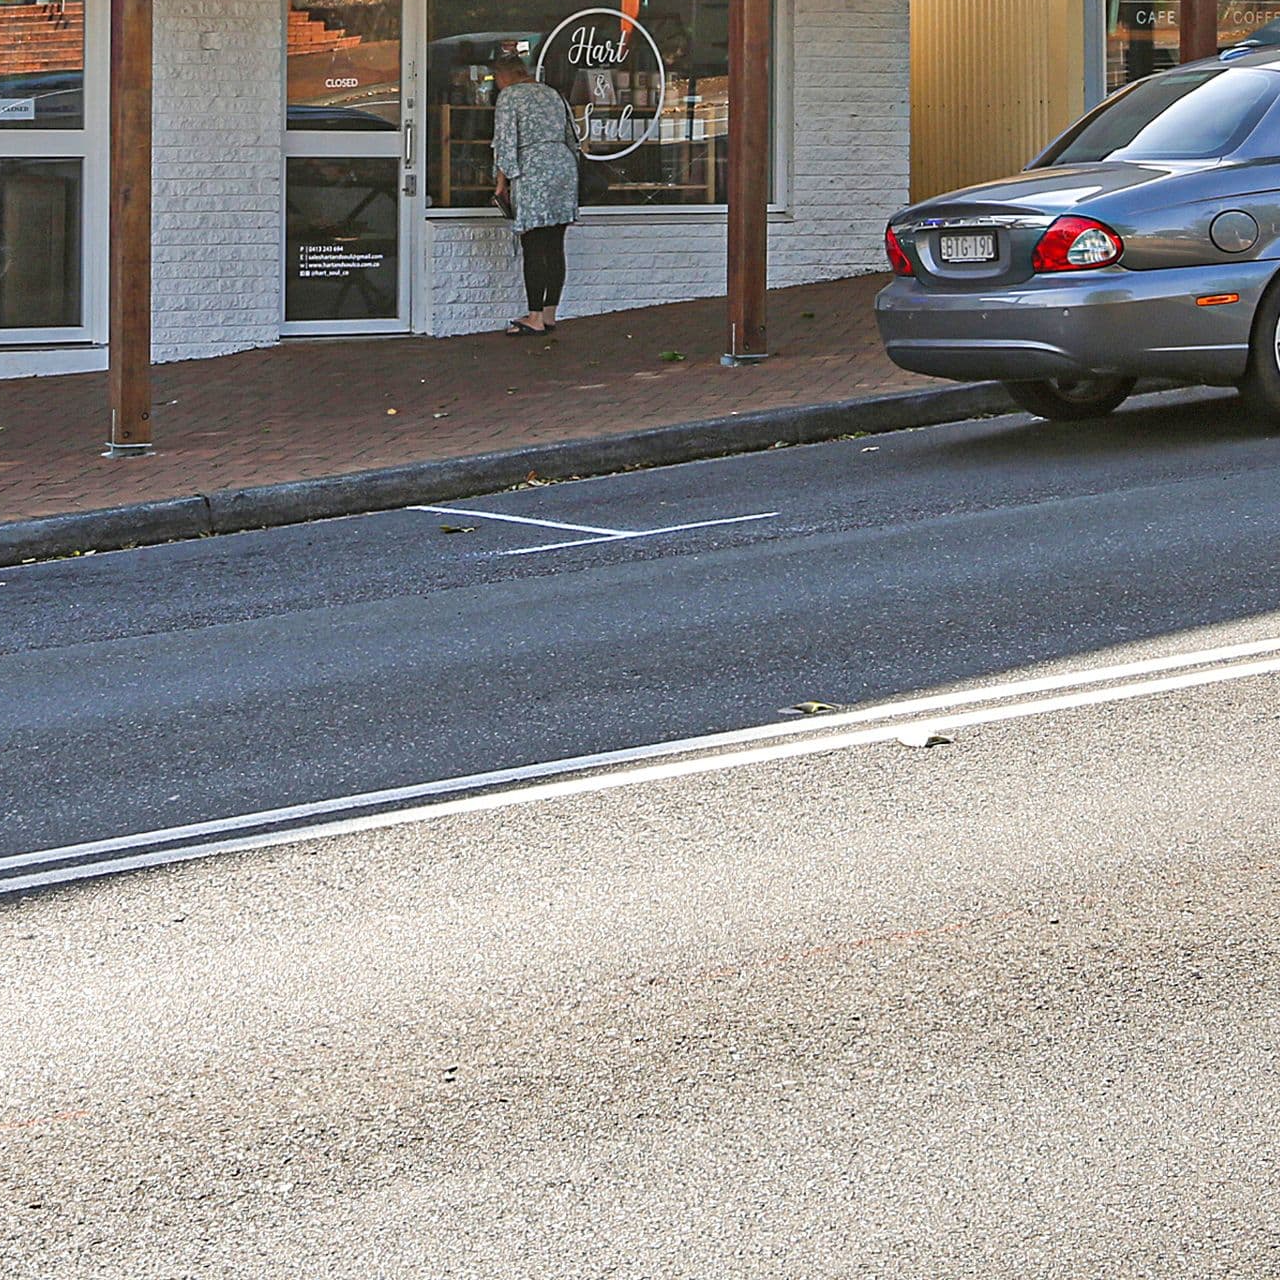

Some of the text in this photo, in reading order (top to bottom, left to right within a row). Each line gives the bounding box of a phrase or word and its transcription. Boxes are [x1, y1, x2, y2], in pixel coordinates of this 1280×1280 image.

[1136, 10, 1177, 25] CAFE
[567, 26, 630, 66] Hart
[325, 78, 359, 88] CLOSED
[593, 74, 610, 99] &
[573, 102, 634, 142] Soul
